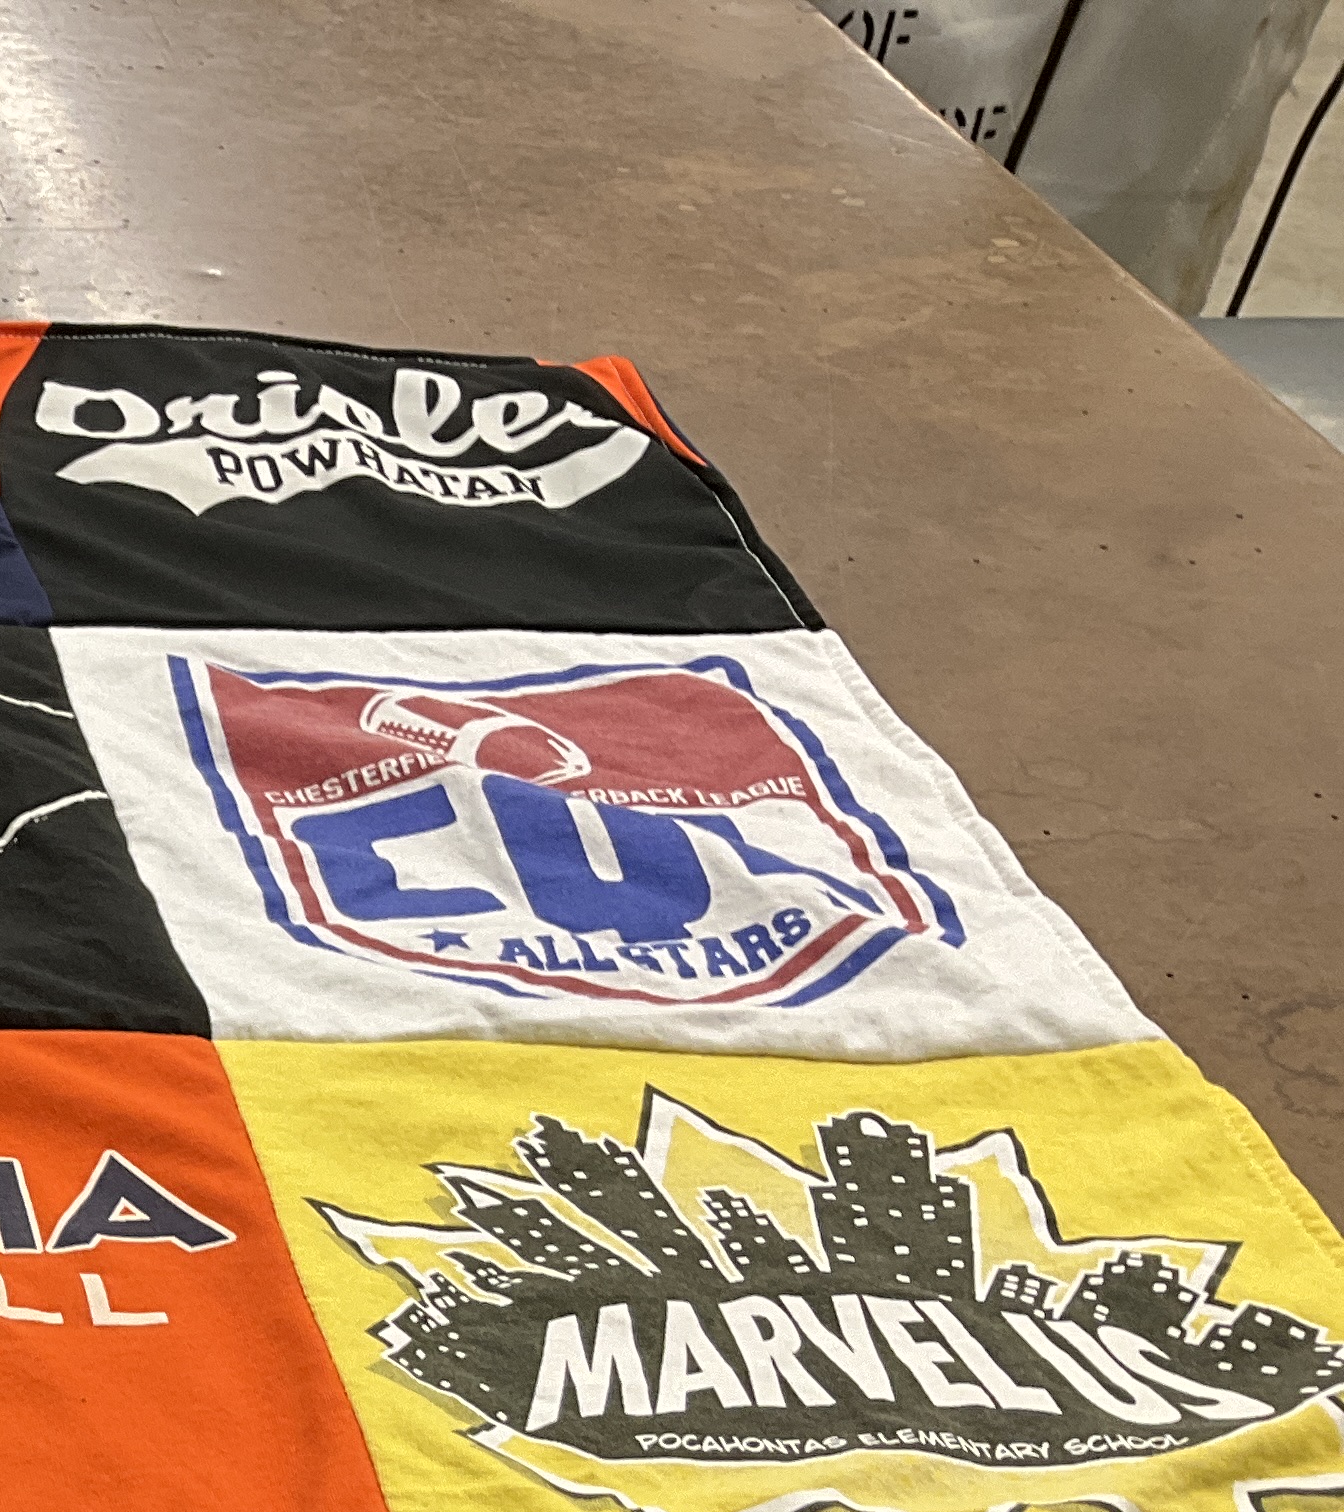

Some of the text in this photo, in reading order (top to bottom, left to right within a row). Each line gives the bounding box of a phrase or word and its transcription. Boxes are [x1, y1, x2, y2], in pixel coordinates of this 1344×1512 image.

[207, 436, 547, 503] POWHATAN
[264, 752, 449, 805] CHESTERFIE
[524, 1293, 1064, 1433] MARVEL
[634, 1427, 1191, 1462] POCAHONTAS ELEMENTARY SCHOOL
